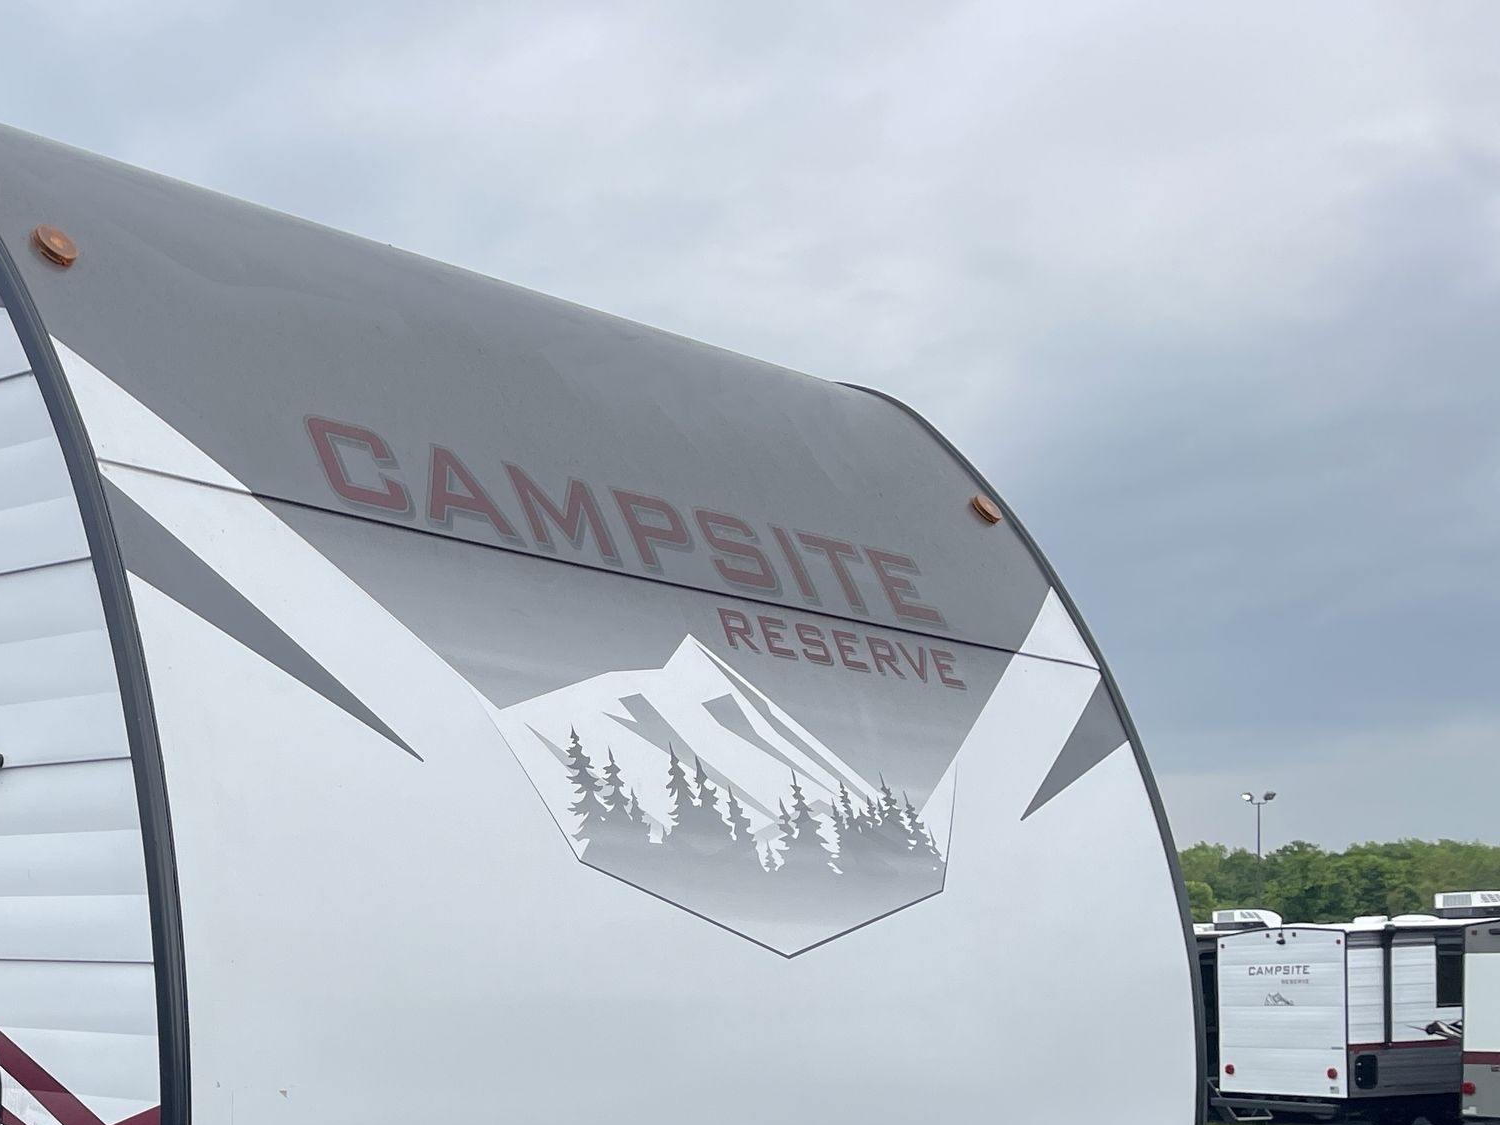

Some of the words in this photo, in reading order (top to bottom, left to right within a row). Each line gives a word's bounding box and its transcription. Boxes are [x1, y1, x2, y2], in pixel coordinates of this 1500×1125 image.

[305, 415, 946, 625] CAMPSITE
[717, 607, 968, 690] RESERVE
[1248, 965, 1311, 976] CAMPSITE
